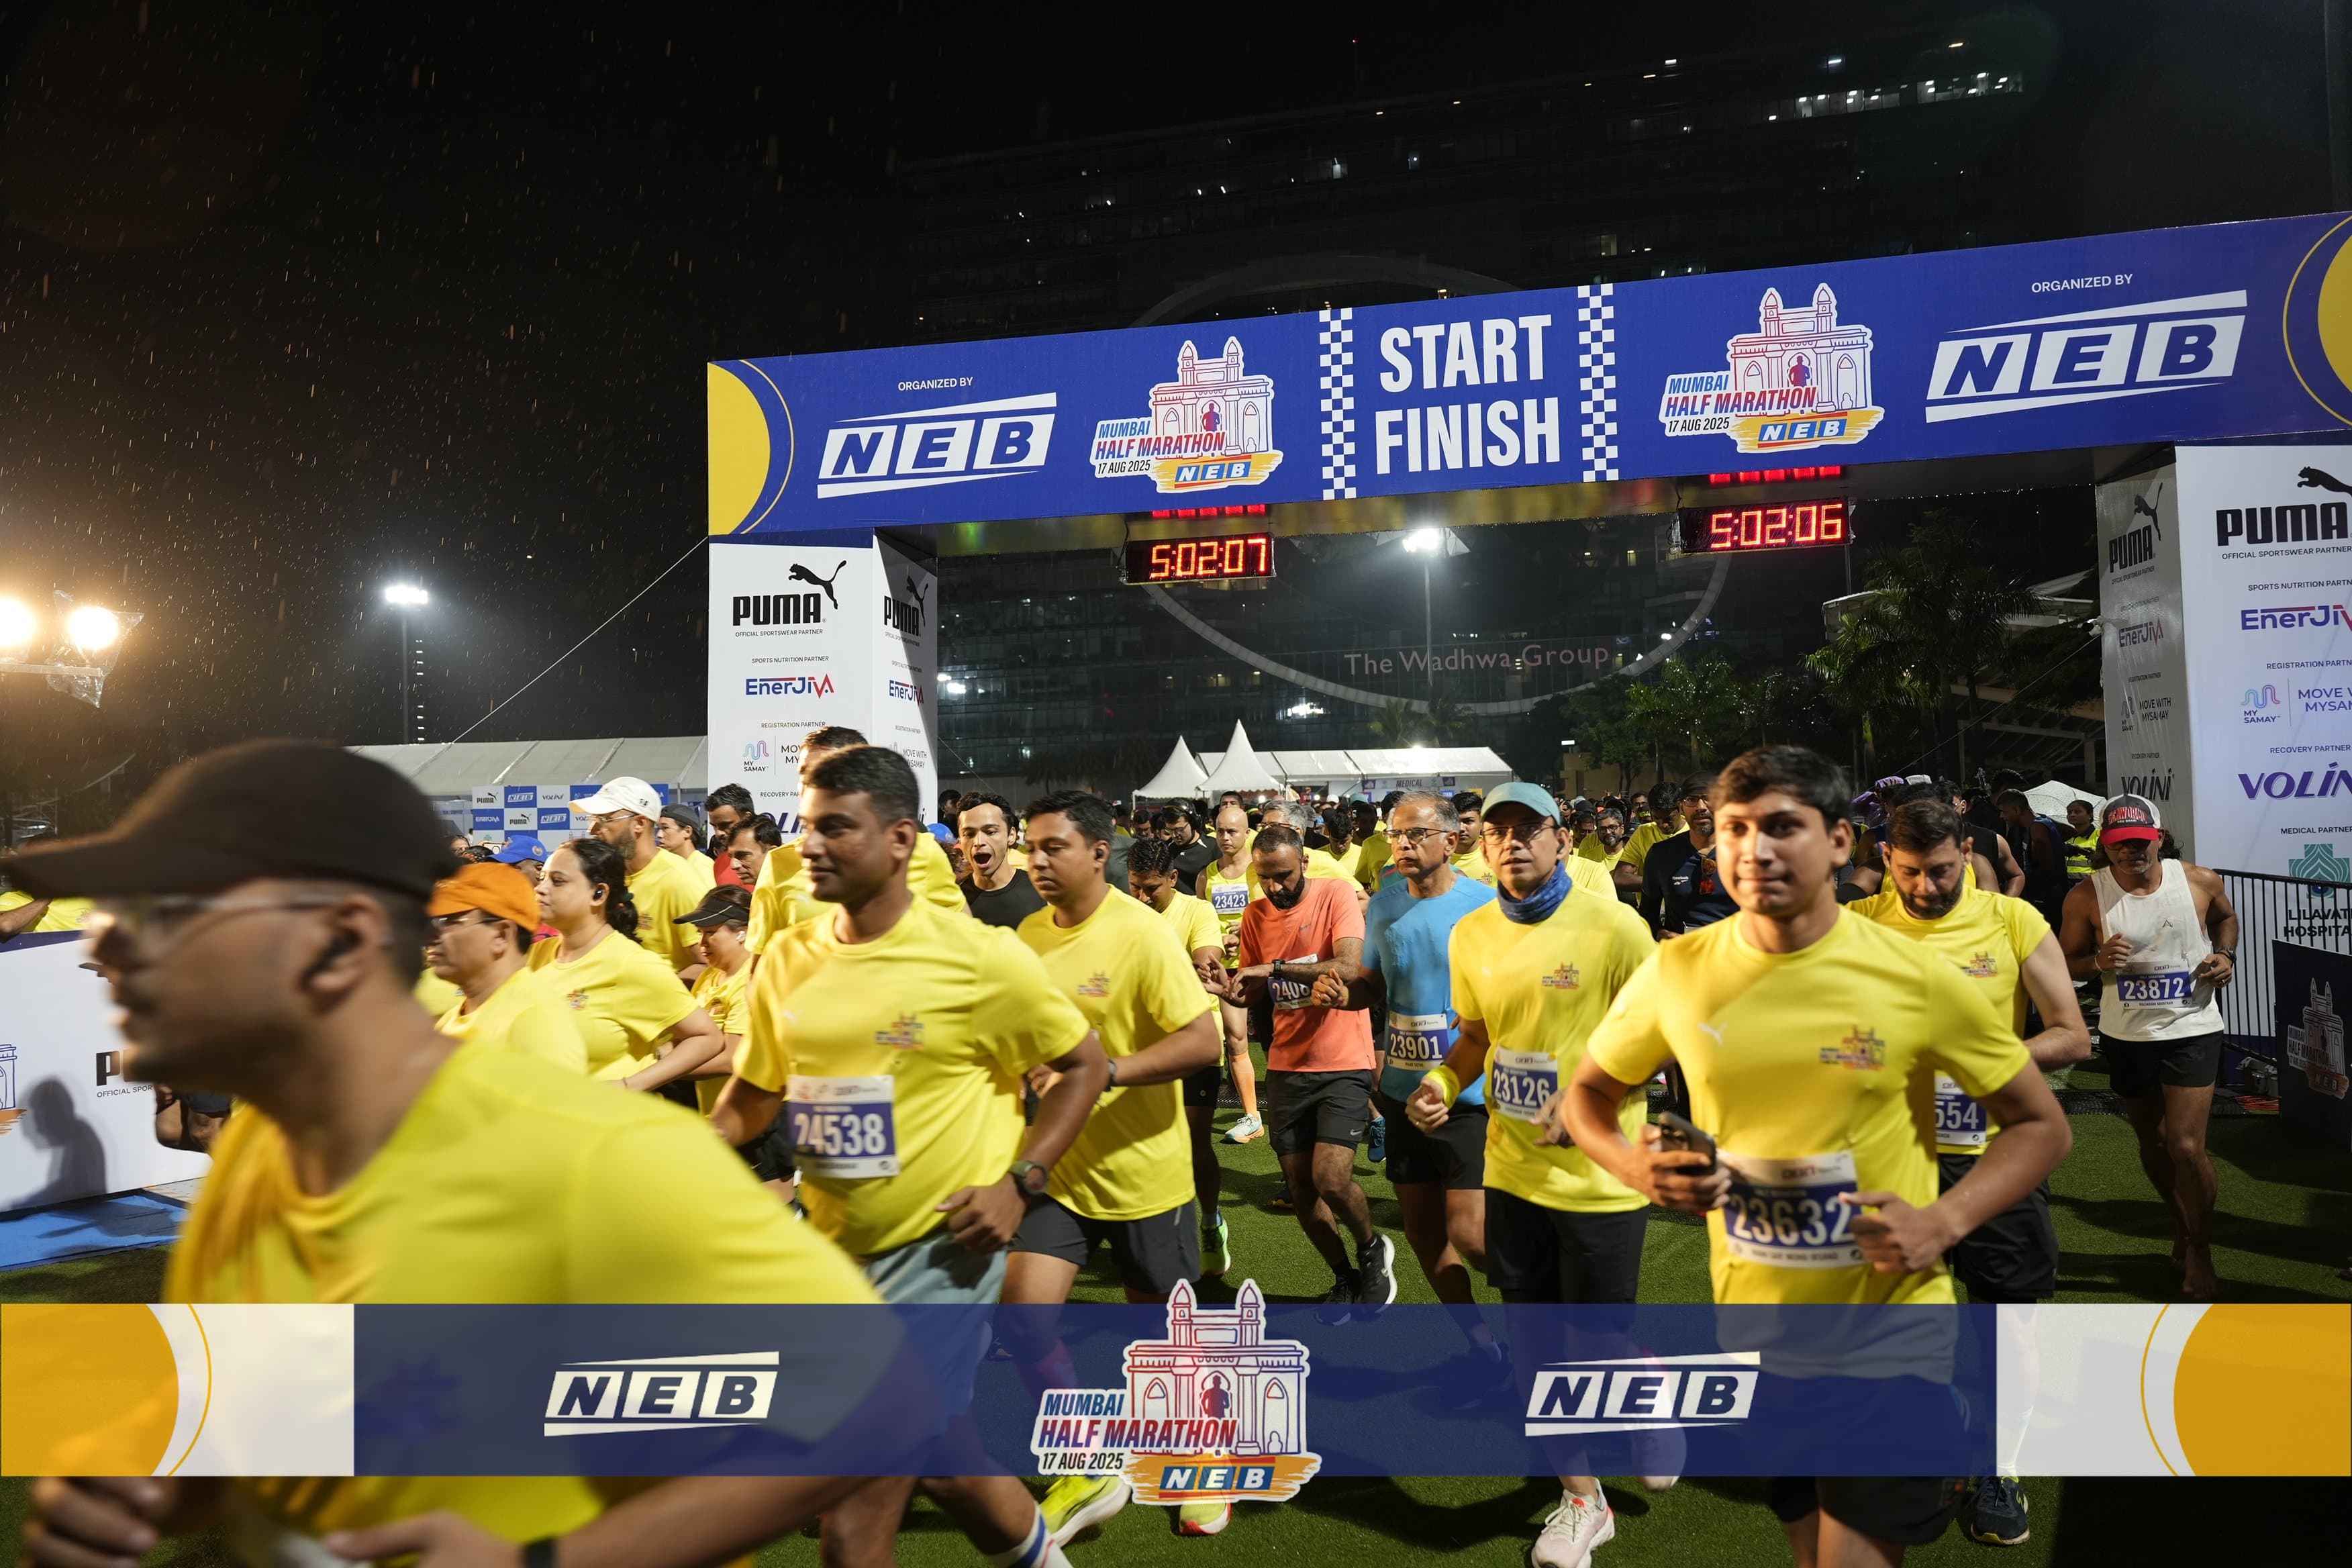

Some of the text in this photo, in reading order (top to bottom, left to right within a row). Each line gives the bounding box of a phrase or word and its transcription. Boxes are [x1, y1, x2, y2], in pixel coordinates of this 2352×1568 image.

[2031, 274, 2133, 293] ORGANIZED BY
[1380, 314, 1551, 392] START
[1926, 315, 2245, 399] NEB
[898, 377, 973, 391] ORGANIZED BY
[1668, 375, 1729, 394] MUMBAI
[1665, 386, 1818, 417] HALF MARATHON
[1098, 420, 1150, 438] MUMBAI
[1669, 417, 1730, 432] 17 AUG 2025
[1759, 420, 1846, 441] NEB
[819, 413, 1055, 479] NEB
[1095, 431, 1226, 460] HALF MARATHON
[1375, 397, 1560, 475] FINISH
[1098, 460, 1150, 475] 17 AUG 2025
[1175, 462, 1251, 482] NEB
[1710, 503, 1842, 548] 5:02:06
[2216, 502, 2349, 546] PUMA
[1150, 538, 1266, 577] 5:02:07
[2109, 525, 2153, 573] PUMA
[2222, 546, 2352, 559] OFFICIAL SPORTSWEAR PARTNER
[2248, 579, 2352, 591] SPORTS NUTRITION PARTN
[733, 593, 821, 626] PUMA
[884, 596, 920, 637] PUMA
[1344, 644, 1610, 675] The Wadhwa Group
[2266, 659, 2352, 670] REGISTRATION PARTN
[2140, 697, 2171, 709] MOVE WITH
[2298, 687, 2343, 699] MOVE
[2305, 701, 2352, 713] MYSA
[2270, 744, 2351, 754] RECOVERY PARTNER
[1395, 779, 1422, 788] MEDICAL
[1215, 894, 1246, 908] 23423
[2284, 926, 2352, 937] HOSPITA
[2124, 977, 2185, 999] 23872
[1391, 1034, 1442, 1059] 23901
[97, 1088, 131, 1097] OFFICIAL
[1494, 1069, 1550, 1108] 23126
[794, 1112, 887, 1156] 24538
[1730, 1193, 1856, 1246] 23632
